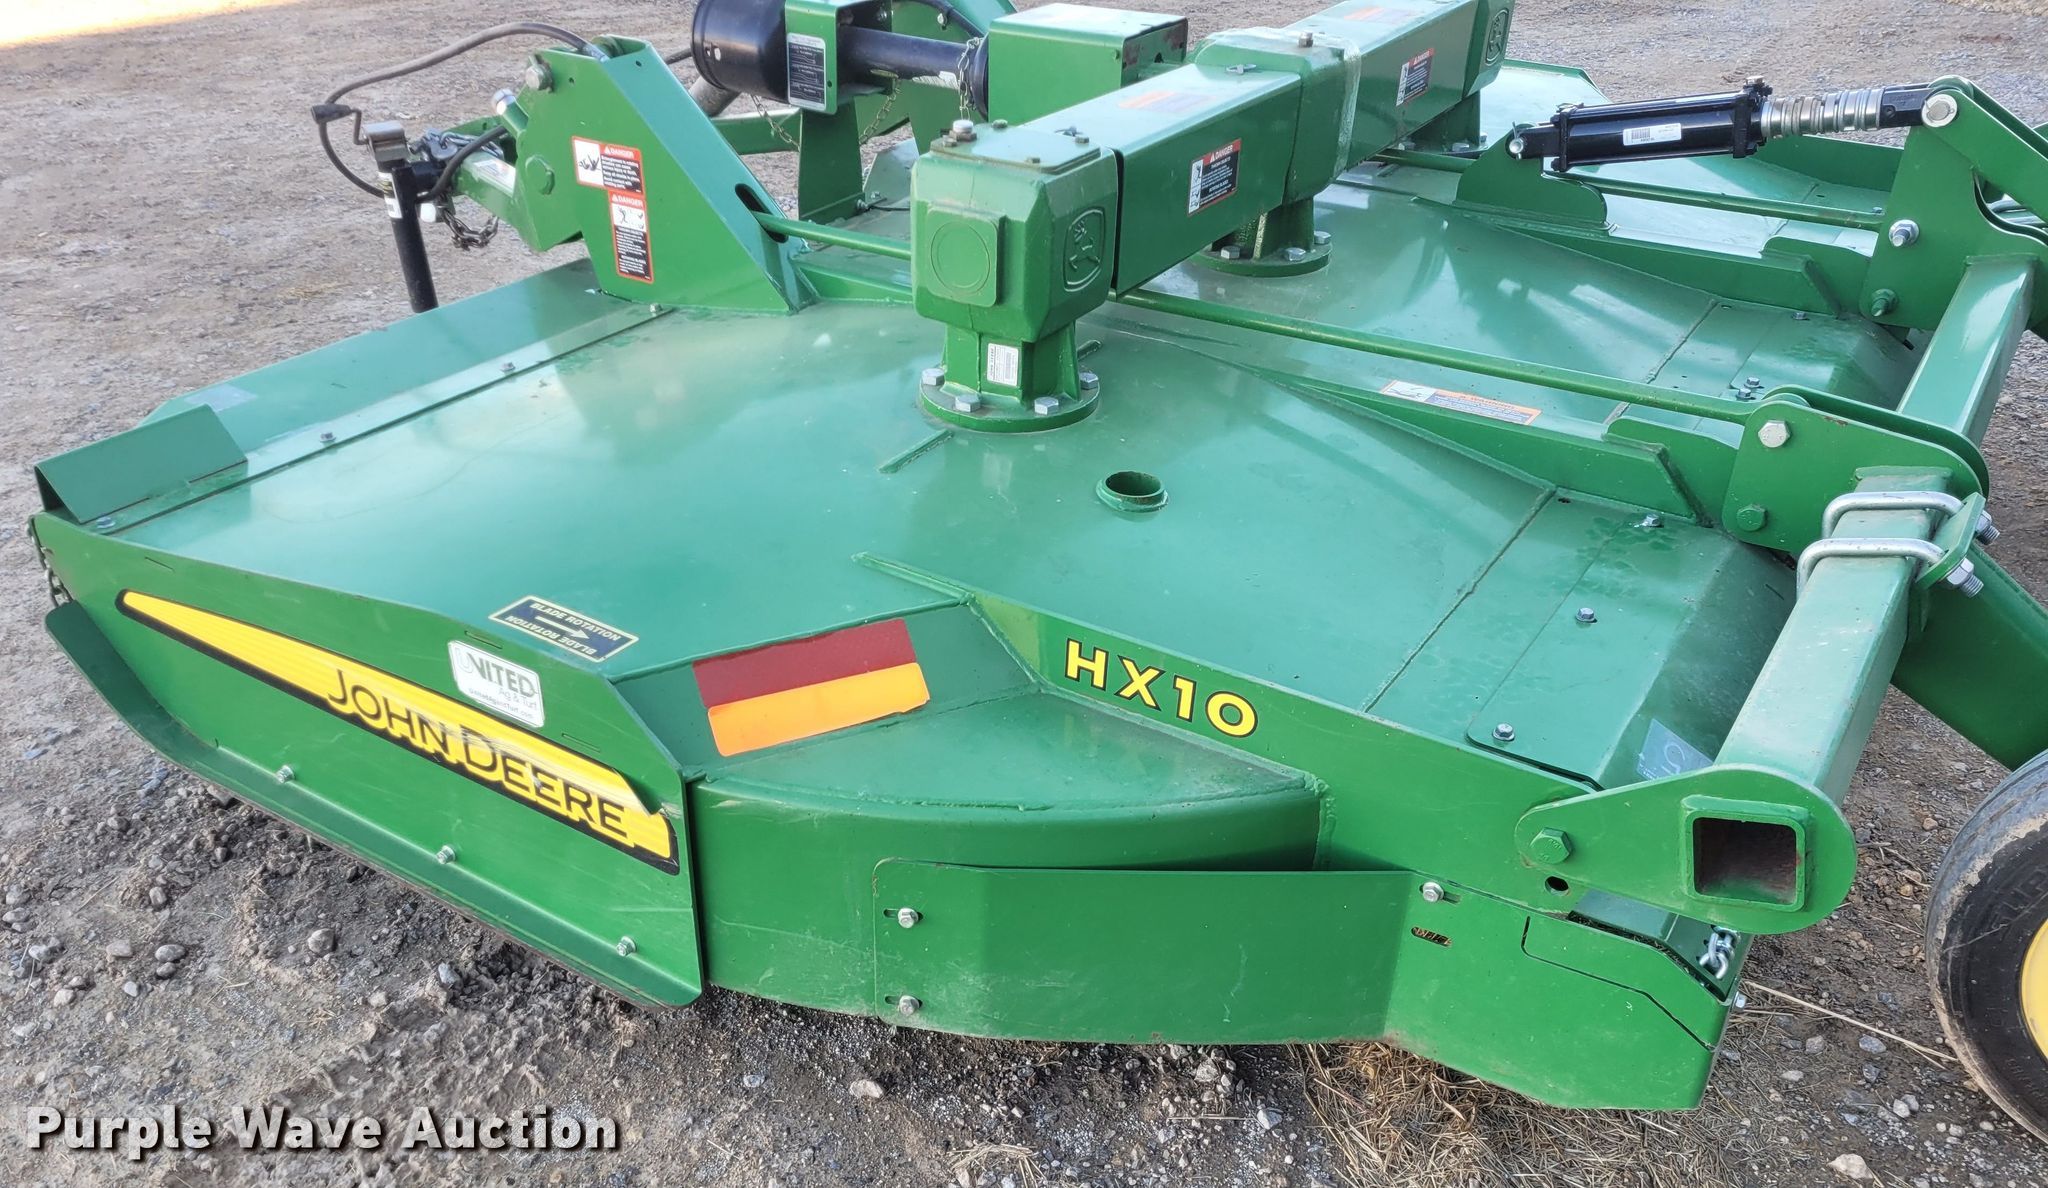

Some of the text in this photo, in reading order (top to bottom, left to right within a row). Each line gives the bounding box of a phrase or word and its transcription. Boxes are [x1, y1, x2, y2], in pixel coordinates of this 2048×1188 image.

[610, 148, 634, 159] DANGER
[1215, 144, 1234, 160] DANGER
[618, 195, 643, 208] DANGER
[505, 615, 597, 655] BLADE ROTATION
[530, 602, 622, 641] BLADE ROTATION
[454, 646, 537, 698] UNITED
[1064, 637, 1259, 739] HX10
[497, 689, 511, 702] Ag
[521, 694, 539, 710] Turf
[327, 669, 631, 839] JOHN DEERE
